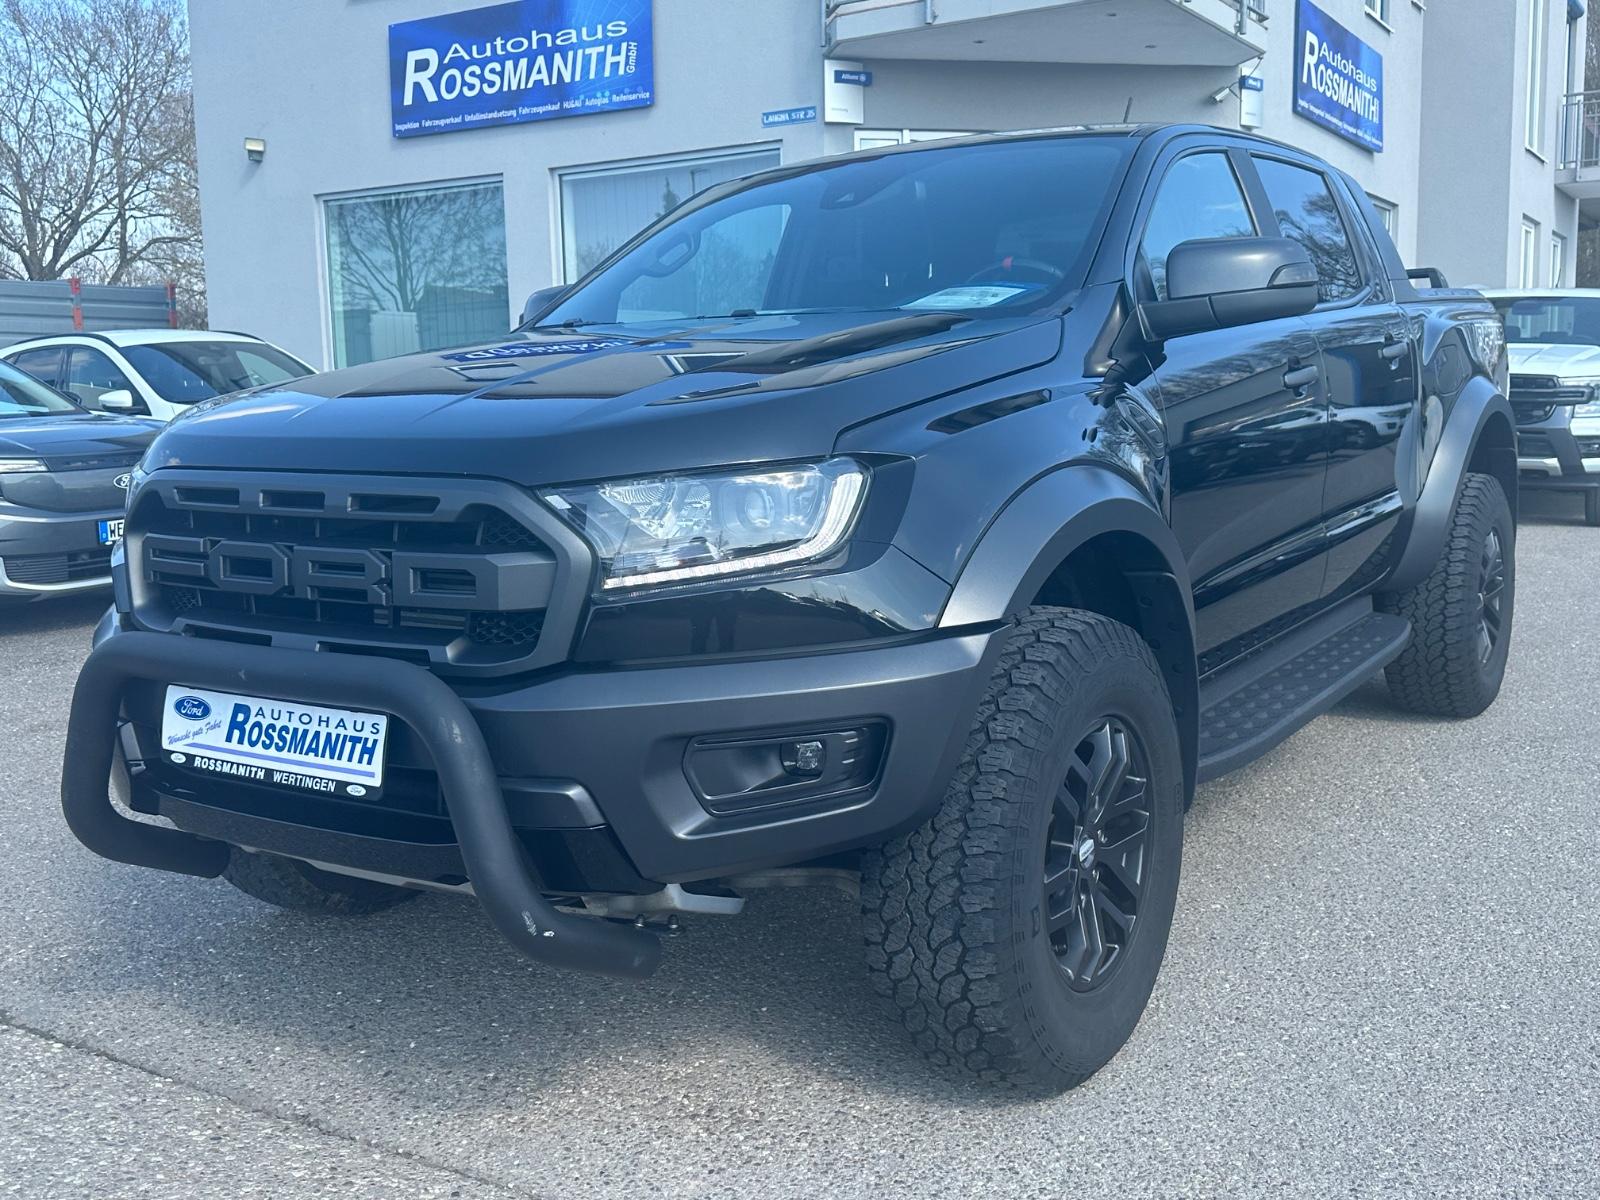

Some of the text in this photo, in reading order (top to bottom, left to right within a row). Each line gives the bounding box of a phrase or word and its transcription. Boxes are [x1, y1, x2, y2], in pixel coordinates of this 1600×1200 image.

[443, 20, 628, 64] Autohaus
[627, 41, 638, 74] GmbH
[403, 41, 627, 106] ROSSMANITH
[1302, 30, 1377, 123] ROSSMANITH
[1319, 42, 1377, 92] Autohaus
[142, 533, 500, 611] FORD
[181, 699, 205, 716] Ford
[254, 706, 381, 735] AUTOHAUS
[225, 703, 379, 766] ROSSMANITH
[194, 756, 336, 793] ROSSMANITH WERTINGEN
